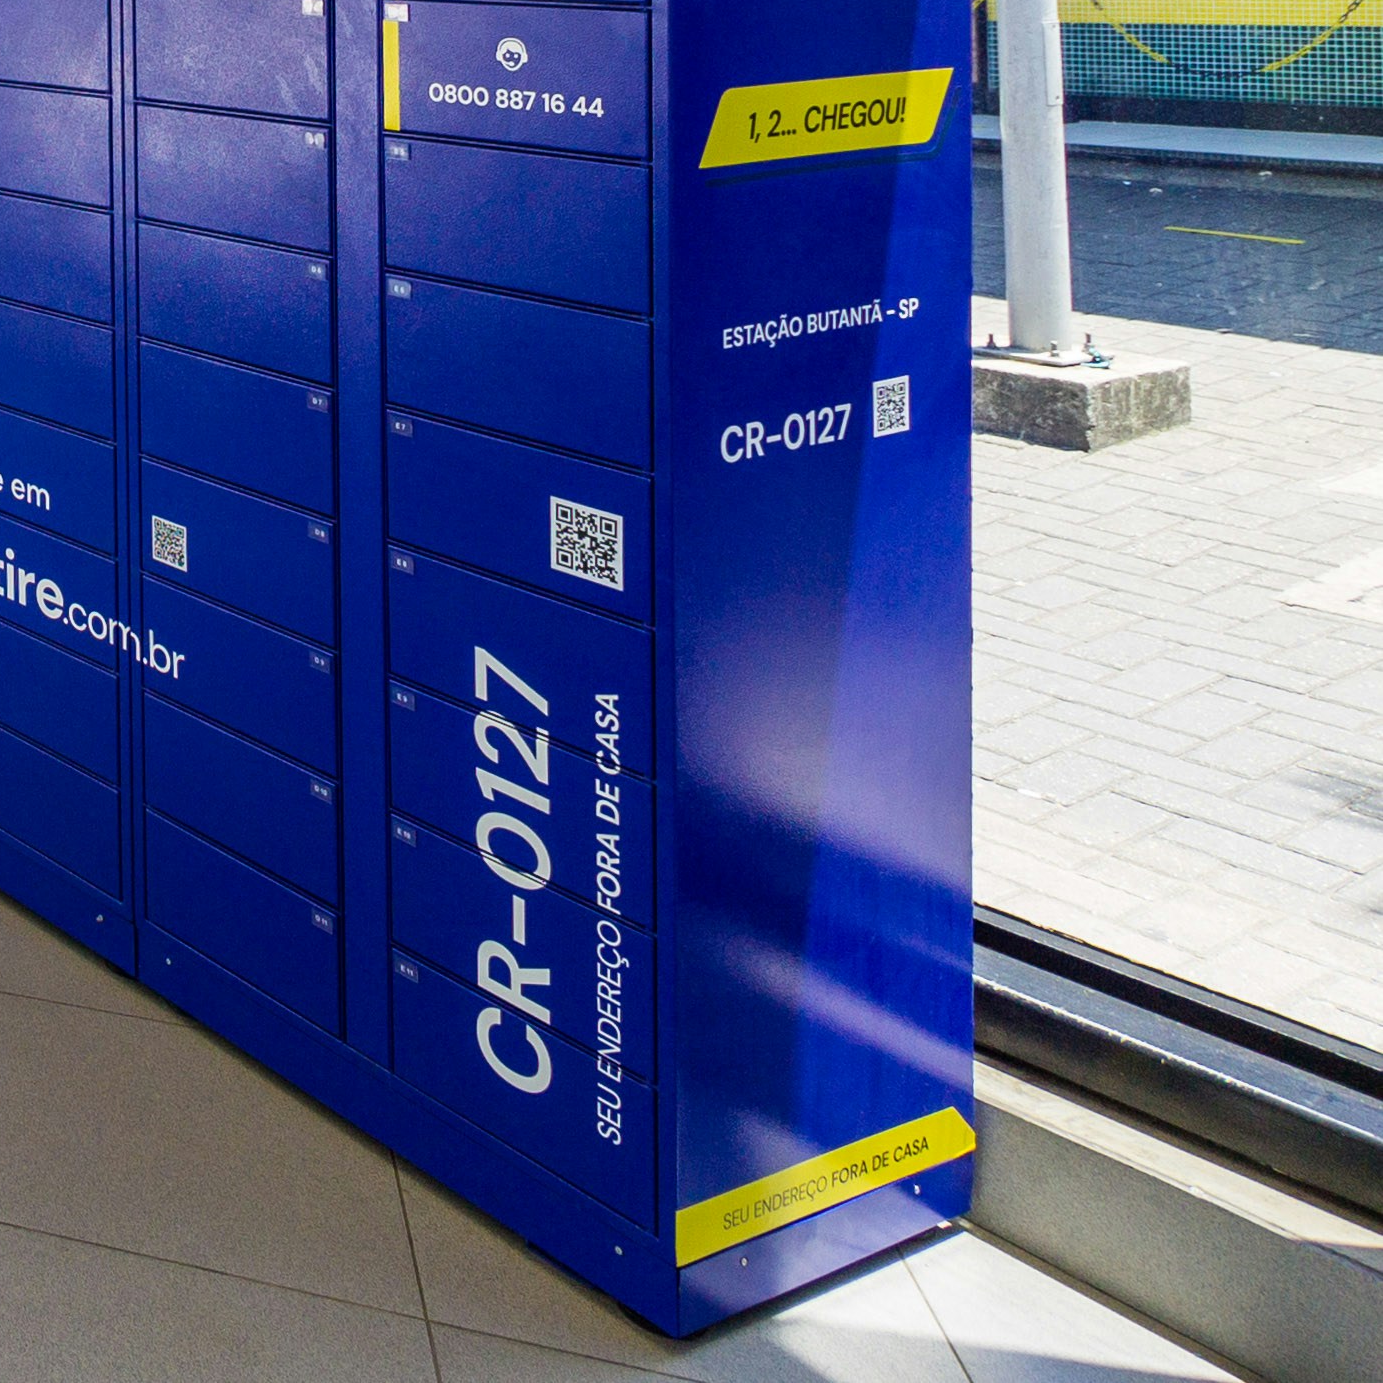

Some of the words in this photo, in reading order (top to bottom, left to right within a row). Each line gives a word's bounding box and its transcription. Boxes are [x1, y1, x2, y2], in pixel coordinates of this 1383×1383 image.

[428, 82, 490, 107] 0800
[495, 87, 537, 110] 887
[541, 92, 566, 113] 16
[571, 95, 604, 117] 44
[748, 110, 760, 142] 1,
[767, 108, 797, 139] 2...
[803, 96, 907, 134] CHEGOU!
[722, 312, 803, 349] ESTAÇÃO
[807, 298, 882, 333] BUTANTÃ
[899, 298, 919, 319] SP
[719, 403, 852, 463] CR-0127
[11, 476, 50, 510] em
[595, 693, 622, 775] CASA
[596, 779, 621, 826] DE
[475, 646, 552, 1095] CR-0127
[596, 832, 622, 930] FORA
[597, 935, 629, 1072] ENDEREÇO
[597, 1075, 622, 1146] SEU
[722, 1204, 751, 1231] SEU
[753, 1177, 828, 1223] ENDEREÇO
[831, 1160, 869, 1189] FORA
[872, 1153, 891, 1173] DE
[894, 1134, 930, 1167] CASA
